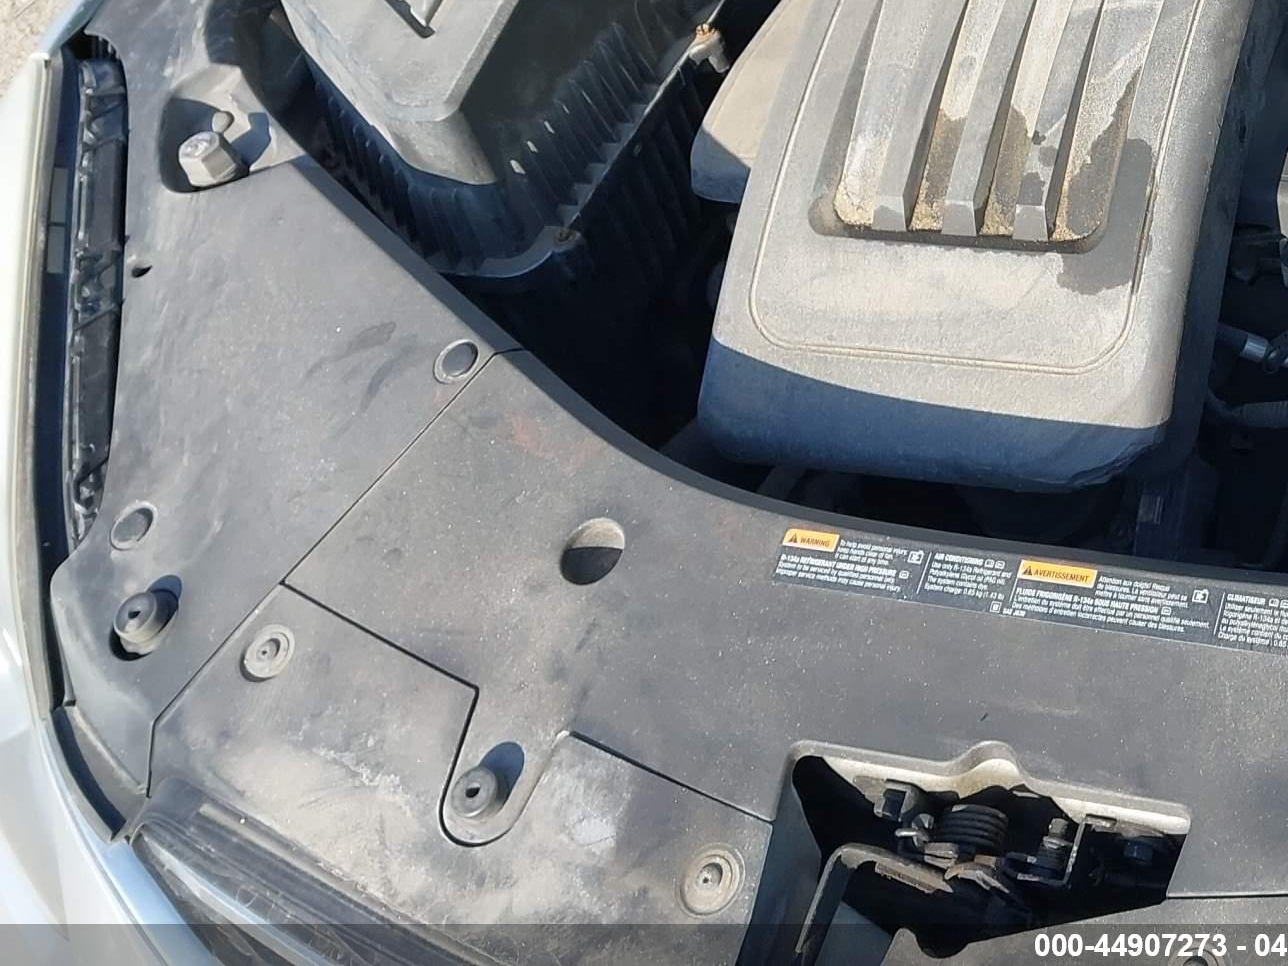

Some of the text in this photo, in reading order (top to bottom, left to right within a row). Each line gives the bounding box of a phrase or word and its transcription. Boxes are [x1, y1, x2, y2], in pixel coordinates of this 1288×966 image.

[800, 537, 830, 547] WARNING
[837, 546, 850, 554] keep
[849, 548, 865, 556] hands
[871, 545, 892, 553] personal
[945, 554, 984, 566] CONDITIONING
[800, 557, 836, 568] REFRIGERANT
[836, 562, 855, 571] UNDER
[855, 564, 868, 573] HIGH
[868, 566, 897, 577] PRESSURE
[953, 564, 973, 573] R-134a
[973, 567, 1001, 577] Refrigerant
[798, 571, 815, 580] service
[810, 566, 831, 575] serviced
[838, 570, 860, 579] qualified
[1034, 569, 1089, 583] AVERTISSEMENT
[937, 577, 956, 586] system
[956, 580, 977, 589] contains
[1099, 576, 1122, 585] Attention
[1016, 587, 1036, 596] FLUIDE
[1073, 595, 1094, 605] R-134a
[1094, 598, 1110, 607] SOUS
[1110, 600, 1129, 610] HAUTE
[1130, 603, 1159, 614] PRESSION
[1167, 593, 1180, 601] peut
[1107, 616, 1128, 625] peuvent
[1134, 612, 1160, 622] personnel
[1252, 614, 1274, 624] R-134a
[1218, 632, 1237, 642] Charge
